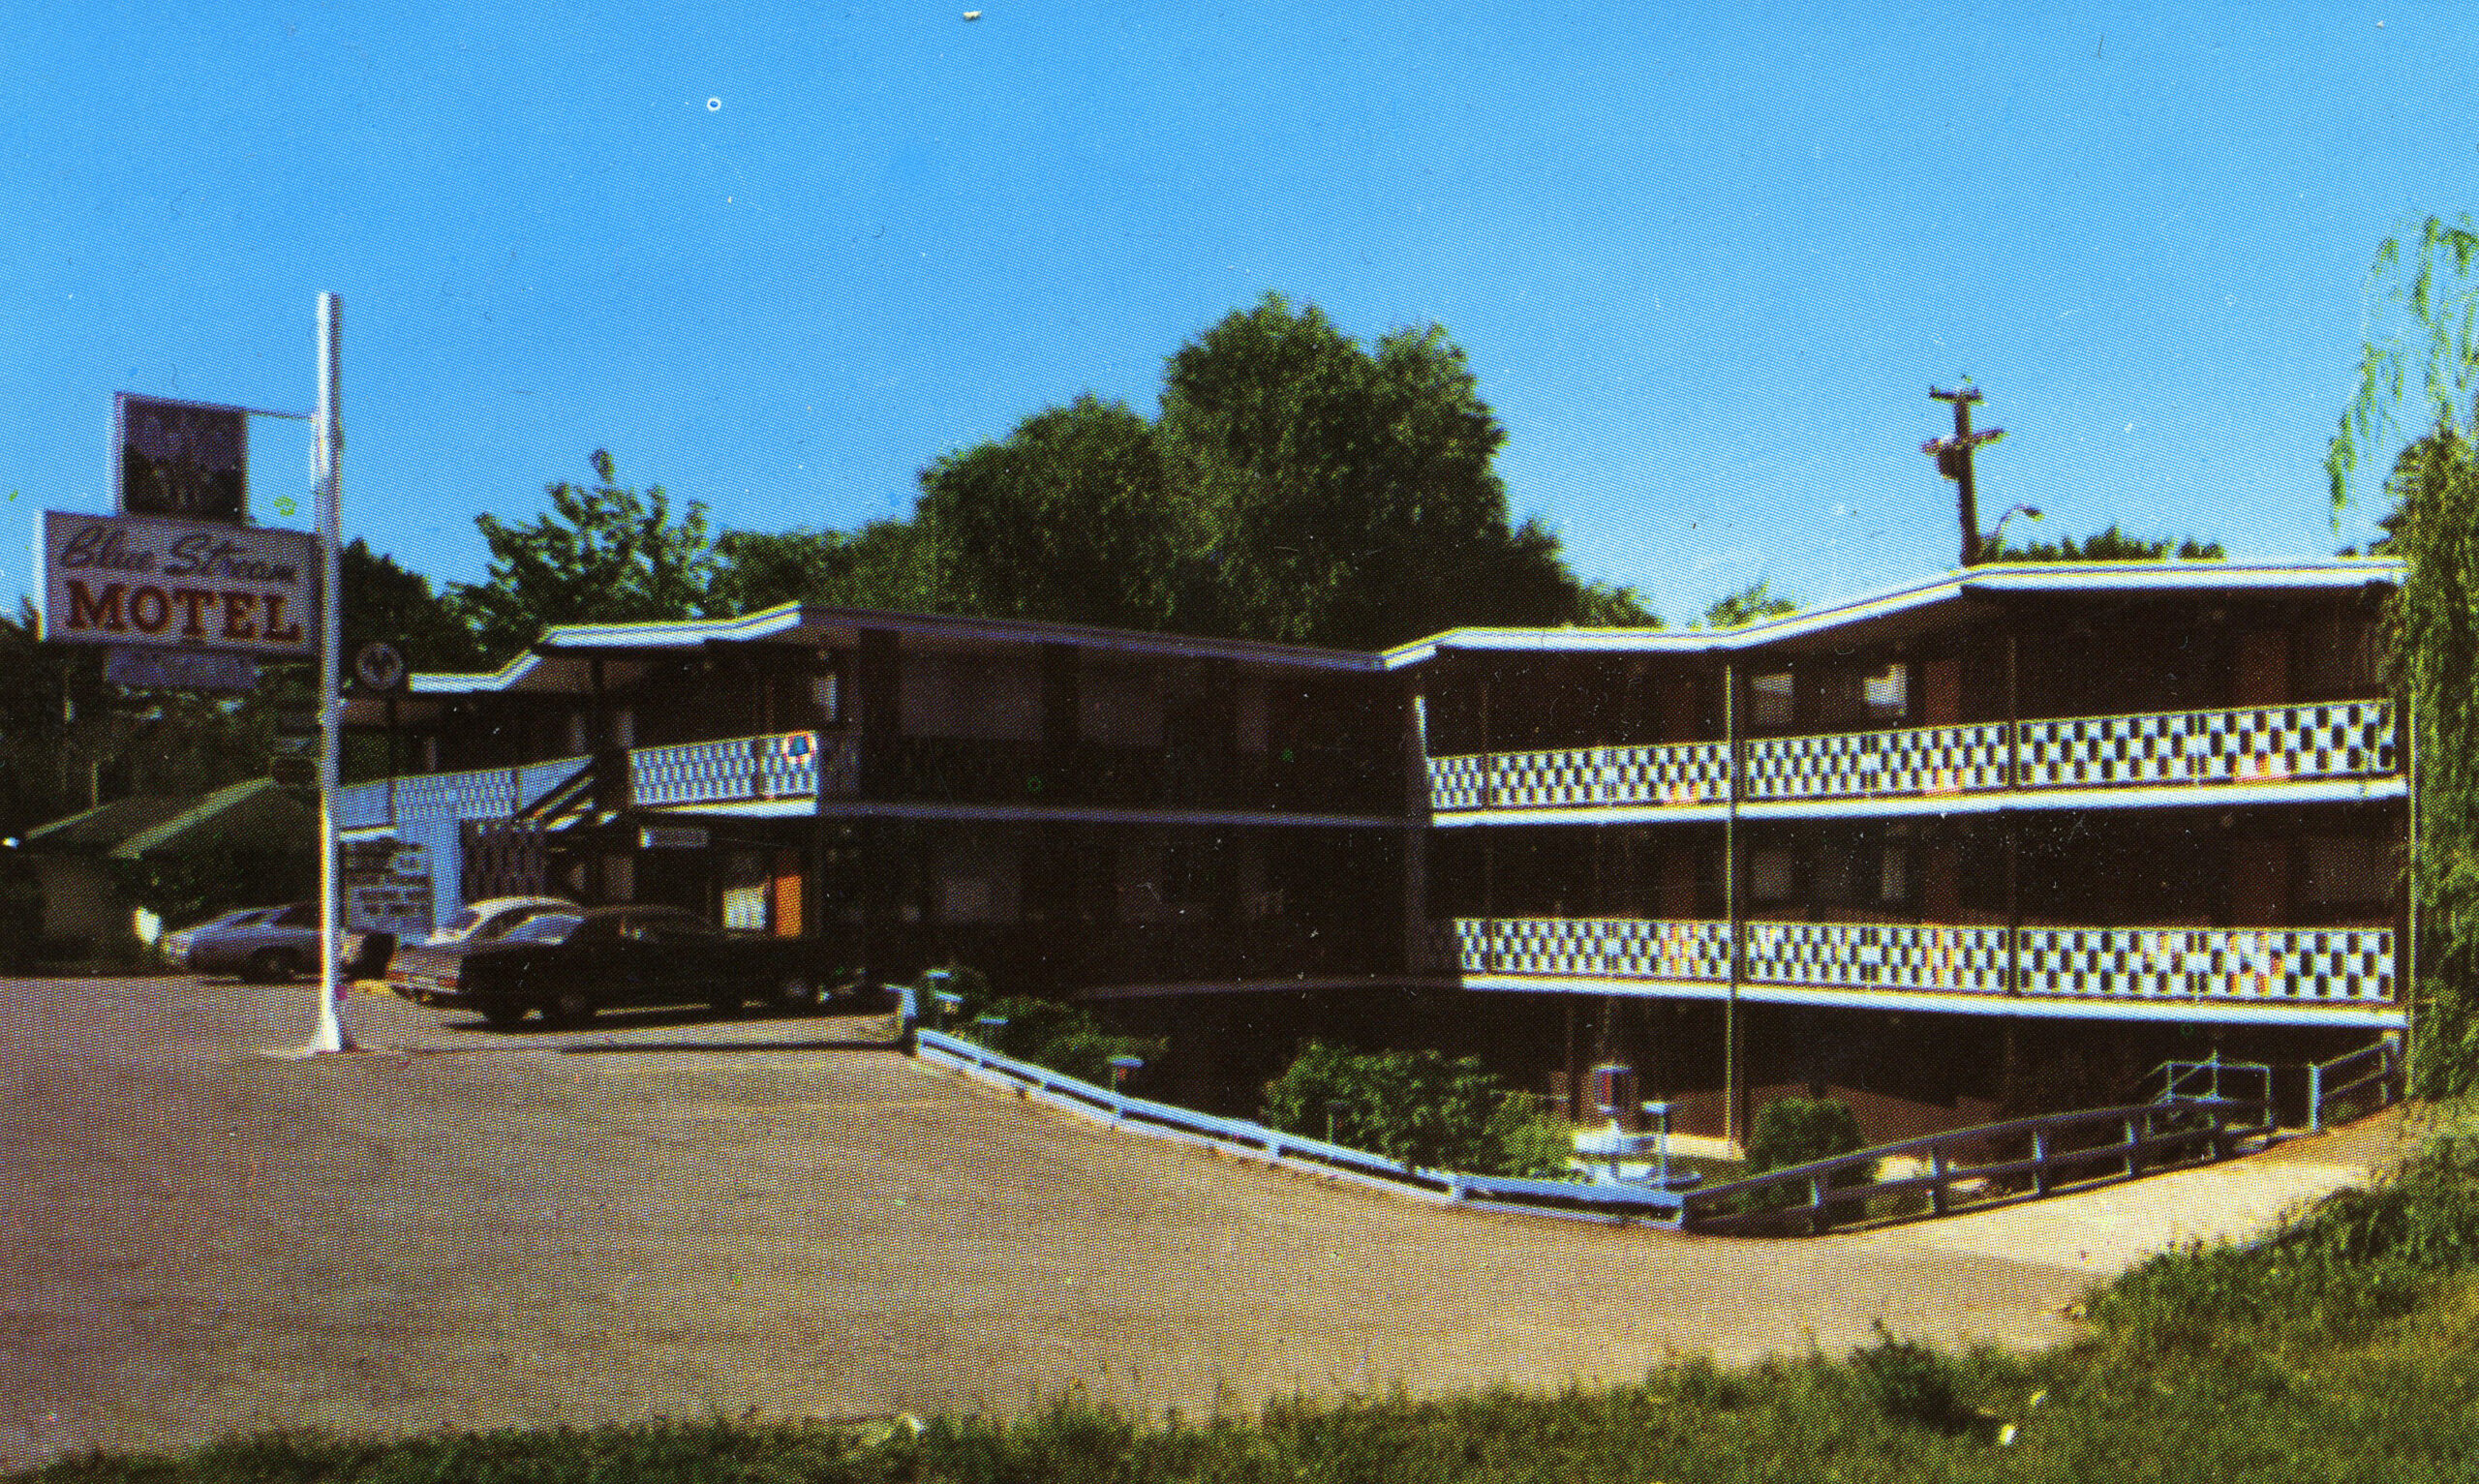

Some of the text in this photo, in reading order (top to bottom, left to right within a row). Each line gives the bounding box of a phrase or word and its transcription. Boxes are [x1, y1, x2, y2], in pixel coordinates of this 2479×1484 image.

[60, 524, 297, 583] Blue Stream
[65, 580, 302, 643] MOTEL
